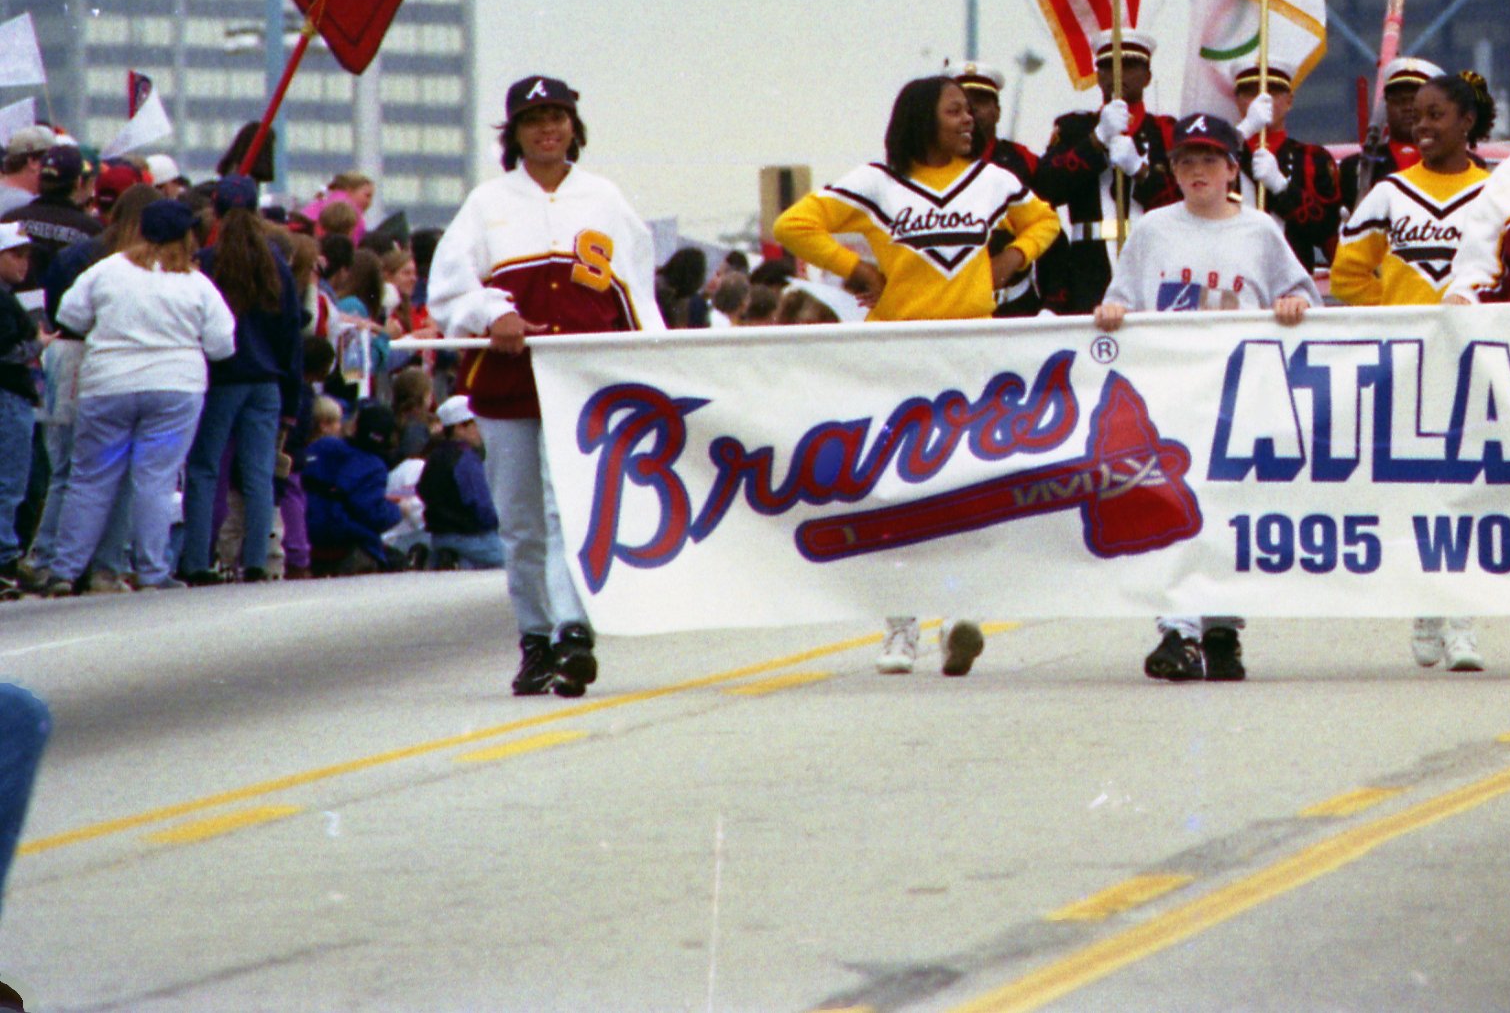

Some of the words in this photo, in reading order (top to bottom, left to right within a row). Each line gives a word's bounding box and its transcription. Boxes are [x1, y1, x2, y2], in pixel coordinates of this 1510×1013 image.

[890, 206, 987, 237] Astros
[1390, 215, 1463, 247] Astro
[571, 228, 615, 293] S
[576, 349, 1081, 594] Braves
[1228, 513, 1382, 575] 1995
